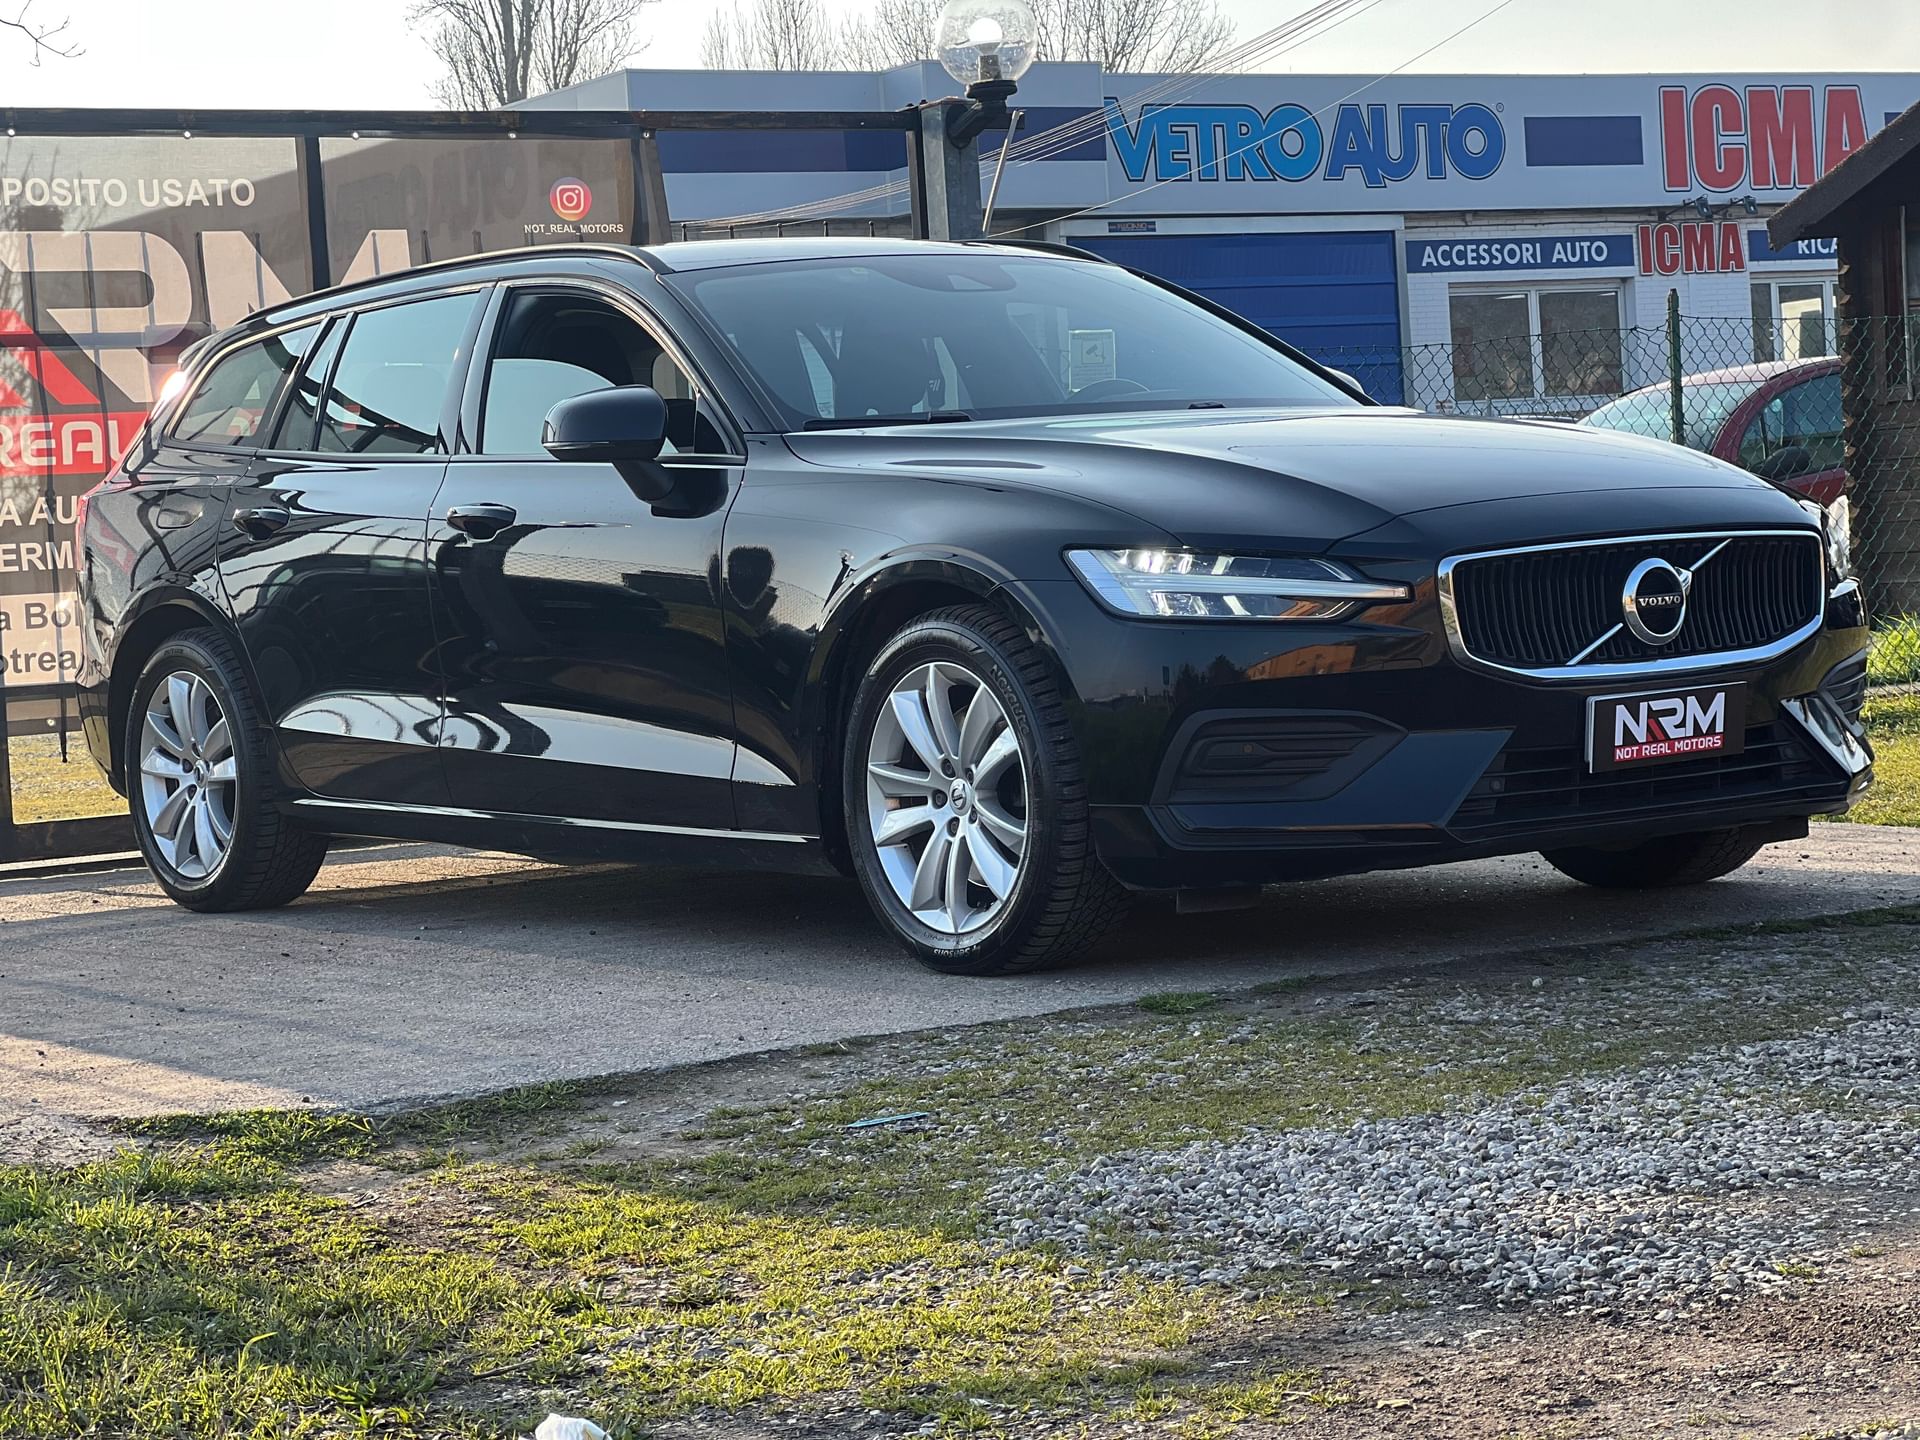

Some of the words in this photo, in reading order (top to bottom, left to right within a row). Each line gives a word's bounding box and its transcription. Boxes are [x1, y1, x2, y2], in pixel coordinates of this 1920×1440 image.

[1104, 97, 1324, 183] VETRO
[1323, 102, 1506, 189] AUTO
[1659, 83, 1870, 193] ICMA
[1, 177, 128, 207] POSITO
[138, 177, 256, 207] USATO
[524, 224, 624, 235] NOT_REAL_MOTORS
[1421, 243, 1542, 267] ACCESSORI
[1551, 241, 1608, 263] AUTO
[1637, 221, 1746, 276] ICMA
[29, 495, 78, 526] AU
[1638, 595, 1680, 606] VOLVO
[1615, 691, 1726, 747] NRM
[1616, 746, 1639, 760] NOT
[1642, 742, 1671, 757] REAL
[1674, 735, 1722, 754] MOTORS
